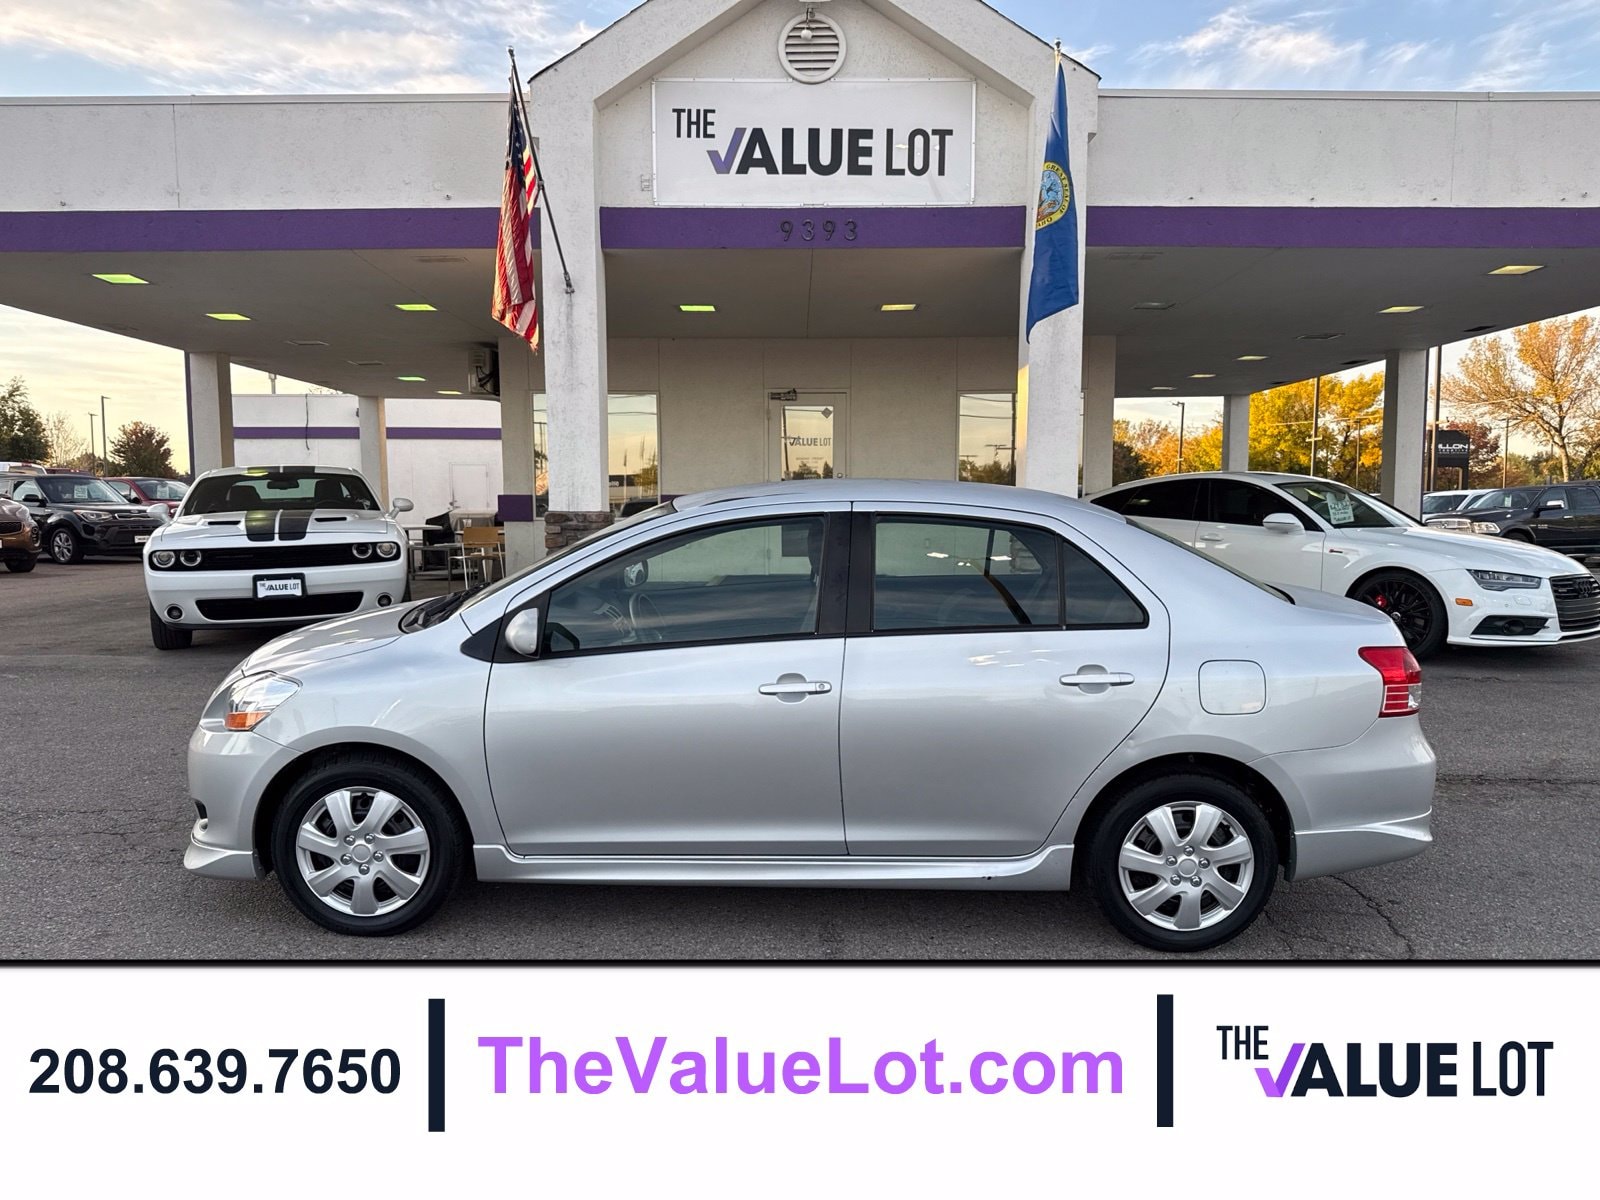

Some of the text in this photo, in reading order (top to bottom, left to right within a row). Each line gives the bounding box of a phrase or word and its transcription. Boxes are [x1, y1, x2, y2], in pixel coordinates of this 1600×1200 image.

[672, 108, 954, 176] THE VALUE LOT
[1046, 163, 1067, 181] GREAT
[780, 219, 858, 242] 9393
[819, 437, 831, 446] LOT
[290, 582, 300, 590] LOT
